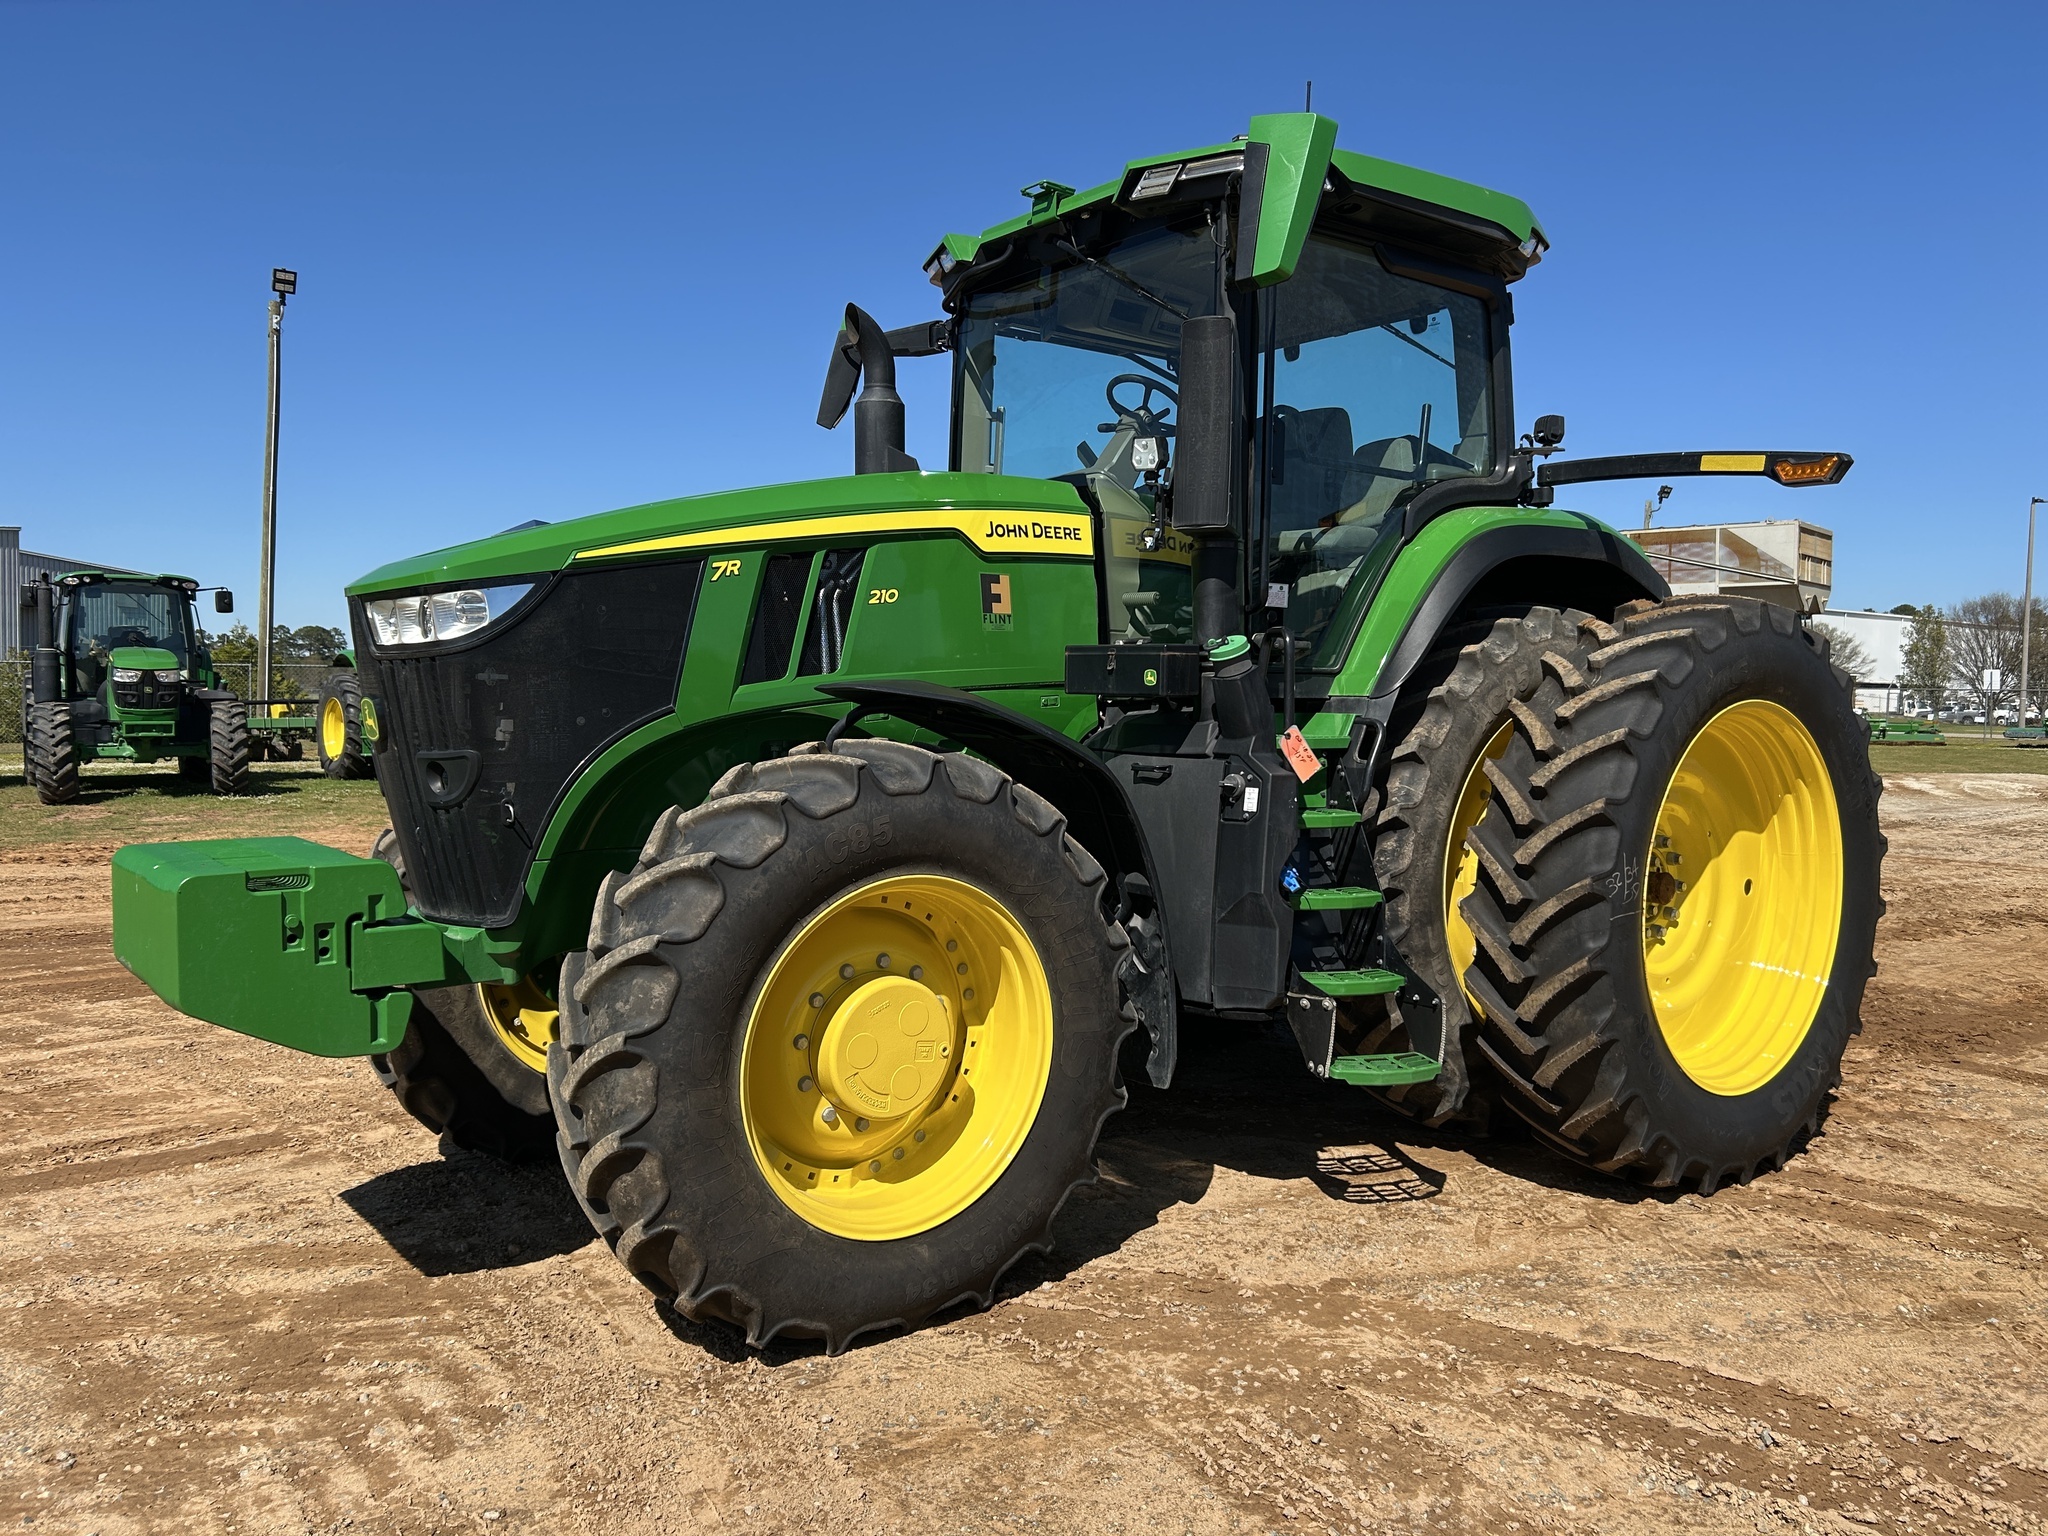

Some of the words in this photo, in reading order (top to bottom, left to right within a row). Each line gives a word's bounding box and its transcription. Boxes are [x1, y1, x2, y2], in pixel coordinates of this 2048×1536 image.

[986, 521, 1029, 538] JOHN
[1032, 522, 1082, 541] DEERE
[709, 560, 741, 582] 7R
[868, 588, 899, 604] 210
[983, 613, 1012, 624] FLINT
[804, 814, 894, 884] AC85
